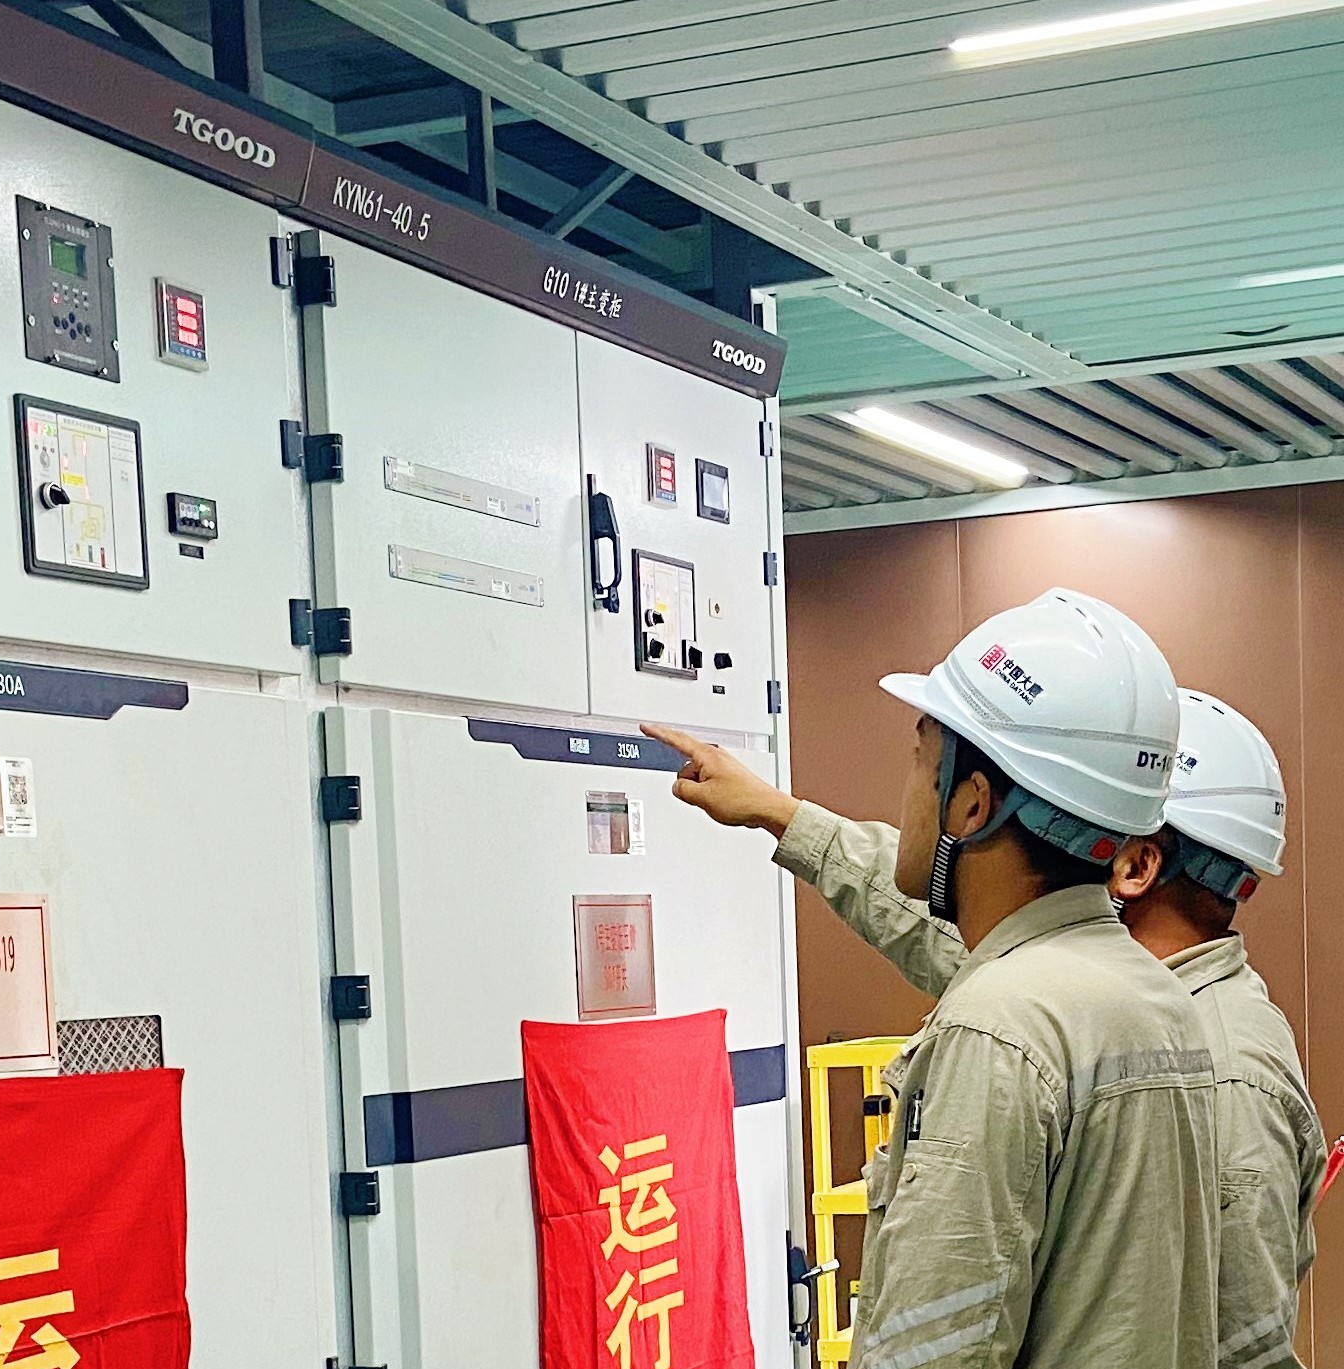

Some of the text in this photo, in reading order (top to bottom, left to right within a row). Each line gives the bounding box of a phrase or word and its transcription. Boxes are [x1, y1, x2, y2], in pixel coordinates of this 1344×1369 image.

[173, 108, 276, 168] TGOOD
[333, 176, 431, 240] KYN61-40.5
[543, 266, 623, 318] G10 1#主变柜
[712, 339, 766, 375] TGOOD
[1001, 658, 1044, 698] 中国大唐
